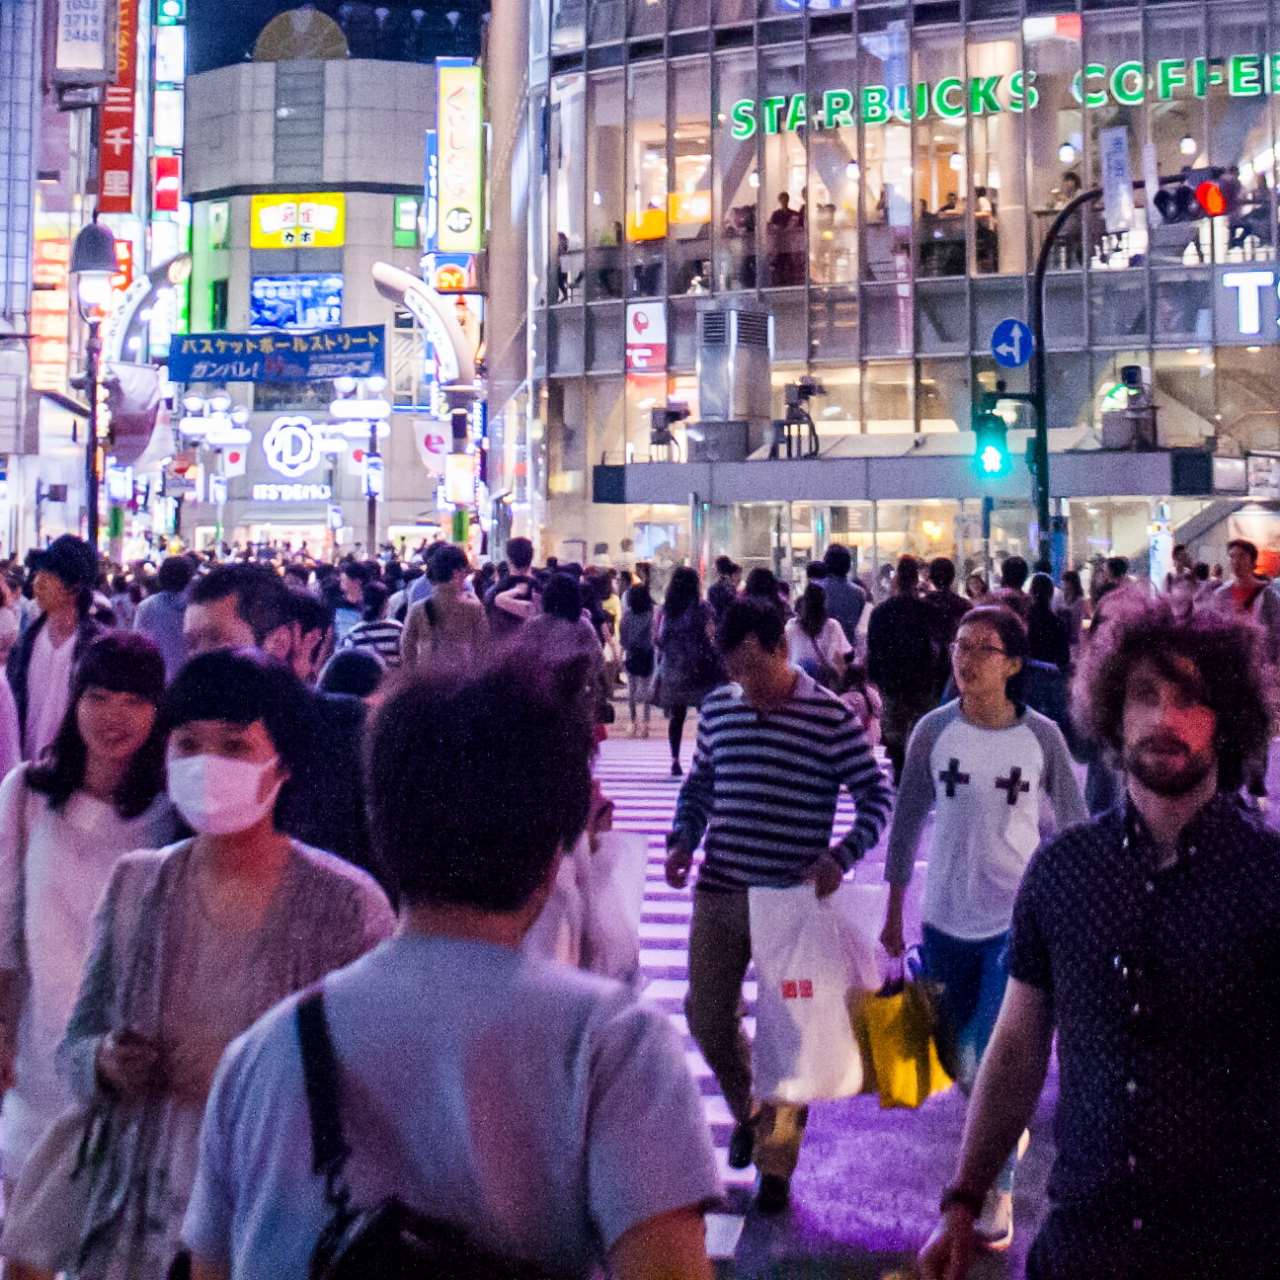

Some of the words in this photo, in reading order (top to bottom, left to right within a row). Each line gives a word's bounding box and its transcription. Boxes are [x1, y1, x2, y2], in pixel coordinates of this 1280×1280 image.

[103, 86, 131, 197] 三千里
[729, 71, 1039, 141] STARBUCKS
